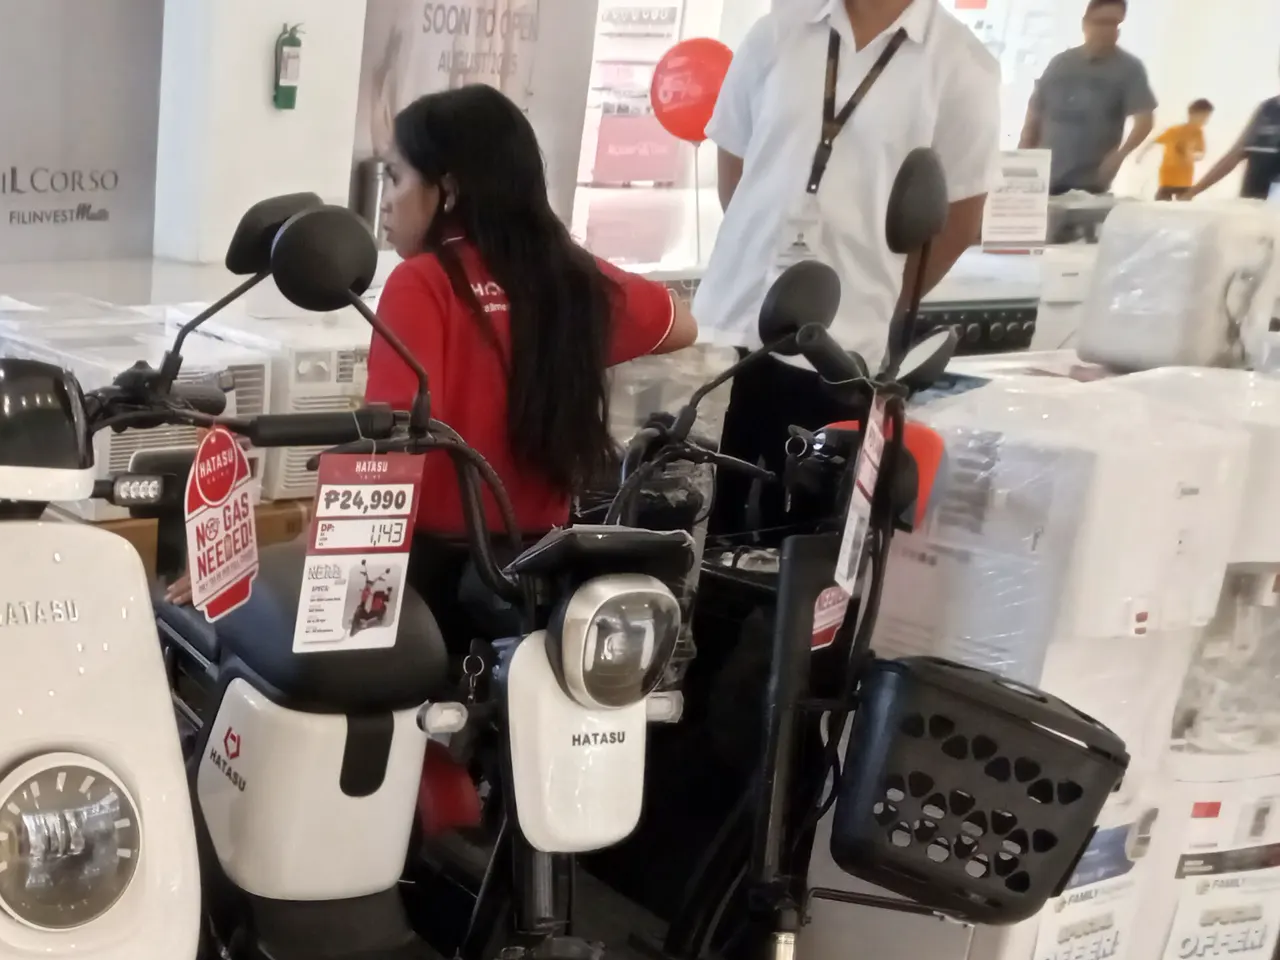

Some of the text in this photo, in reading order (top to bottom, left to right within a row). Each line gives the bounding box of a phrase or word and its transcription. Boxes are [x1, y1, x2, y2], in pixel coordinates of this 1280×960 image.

[422, 3, 471, 36] SOON
[199, 447, 234, 479] HATASU
[355, 461, 388, 473] HATASU
[222, 491, 250, 532] GAS
[370, 523, 404, 547] 1,143
[572, 731, 626, 747] HATASU
[210, 747, 246, 793] HATASU
